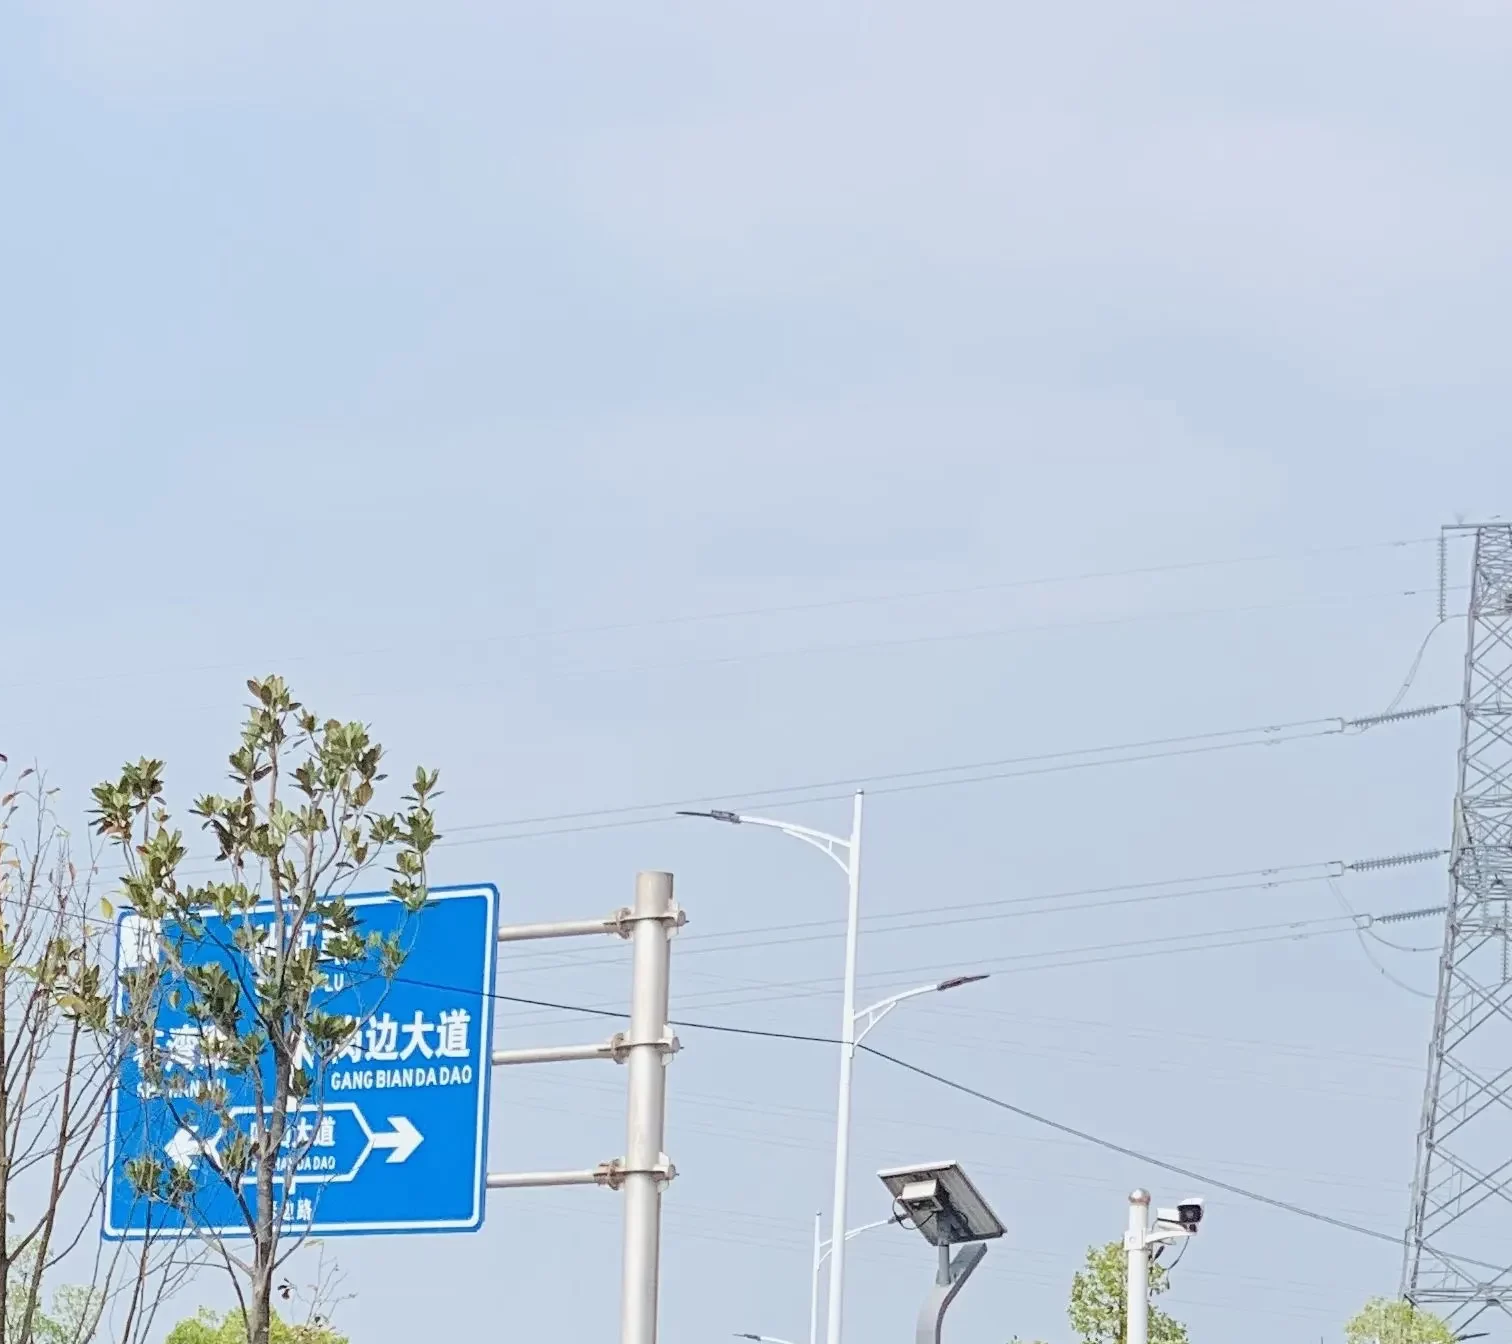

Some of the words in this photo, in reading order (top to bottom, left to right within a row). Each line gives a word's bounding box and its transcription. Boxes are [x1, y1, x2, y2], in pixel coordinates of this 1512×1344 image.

[331, 1070, 373, 1090] GANG
[375, 1068, 413, 1088] BIAN
[415, 1067, 437, 1087] DA
[439, 1065, 472, 1085] DAO
